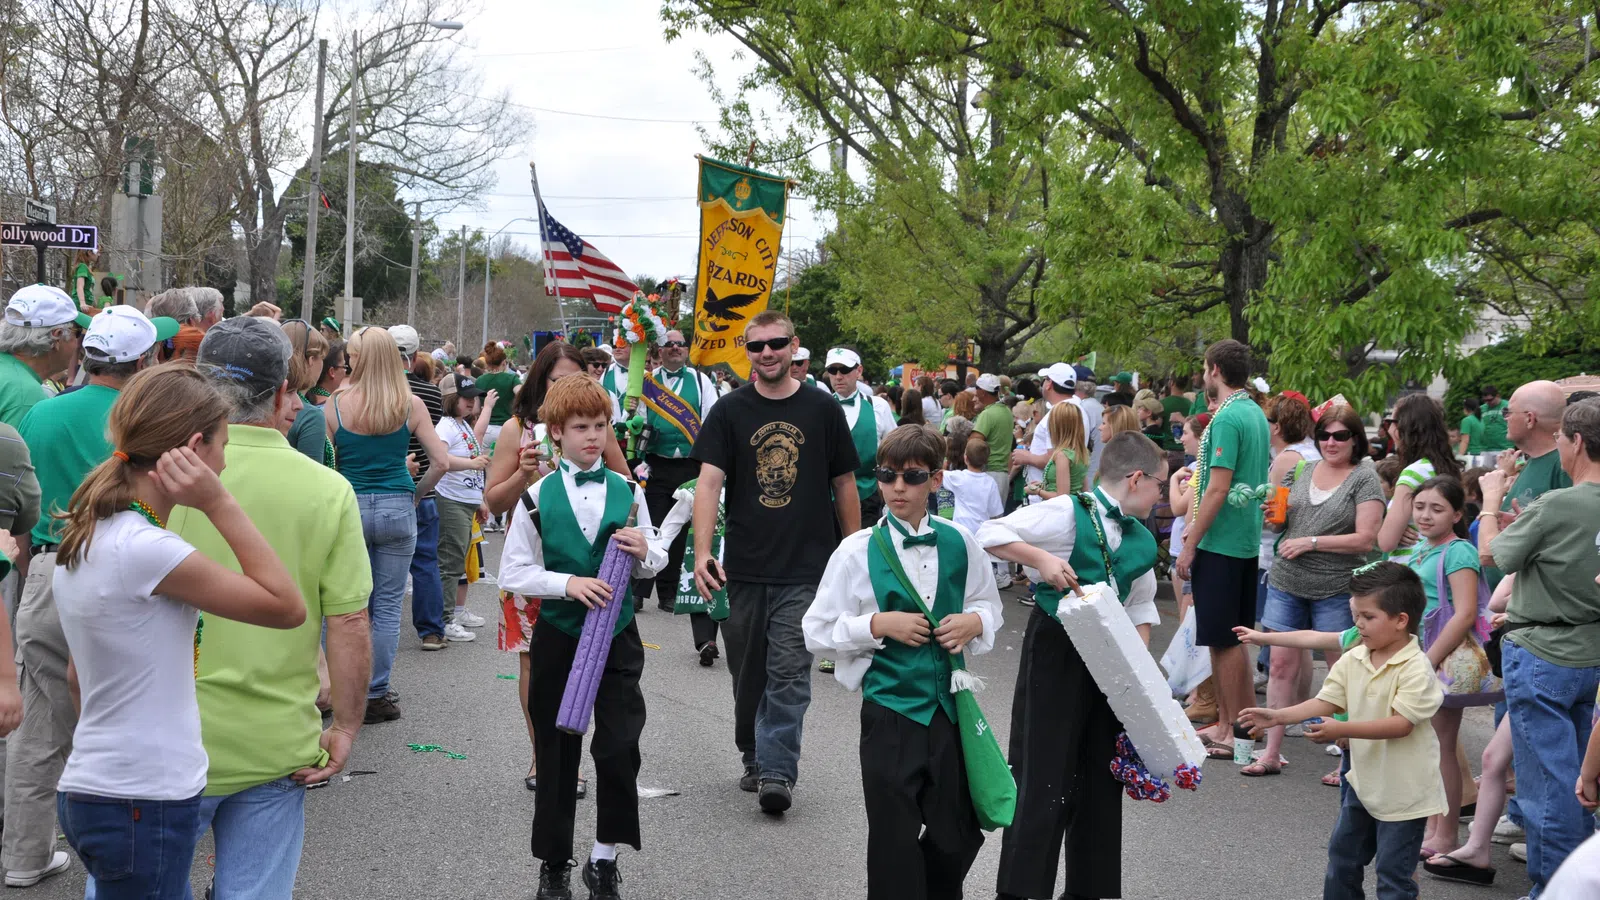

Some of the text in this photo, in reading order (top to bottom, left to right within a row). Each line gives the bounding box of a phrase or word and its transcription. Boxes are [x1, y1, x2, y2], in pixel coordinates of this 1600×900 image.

[71, 228, 91, 243] Dr
[705, 217, 774, 270] JEFFSON CITY
[657, 392, 686, 416] Grand
[757, 423, 798, 437] COPPER COLLAR
[975, 718, 988, 736] JE
